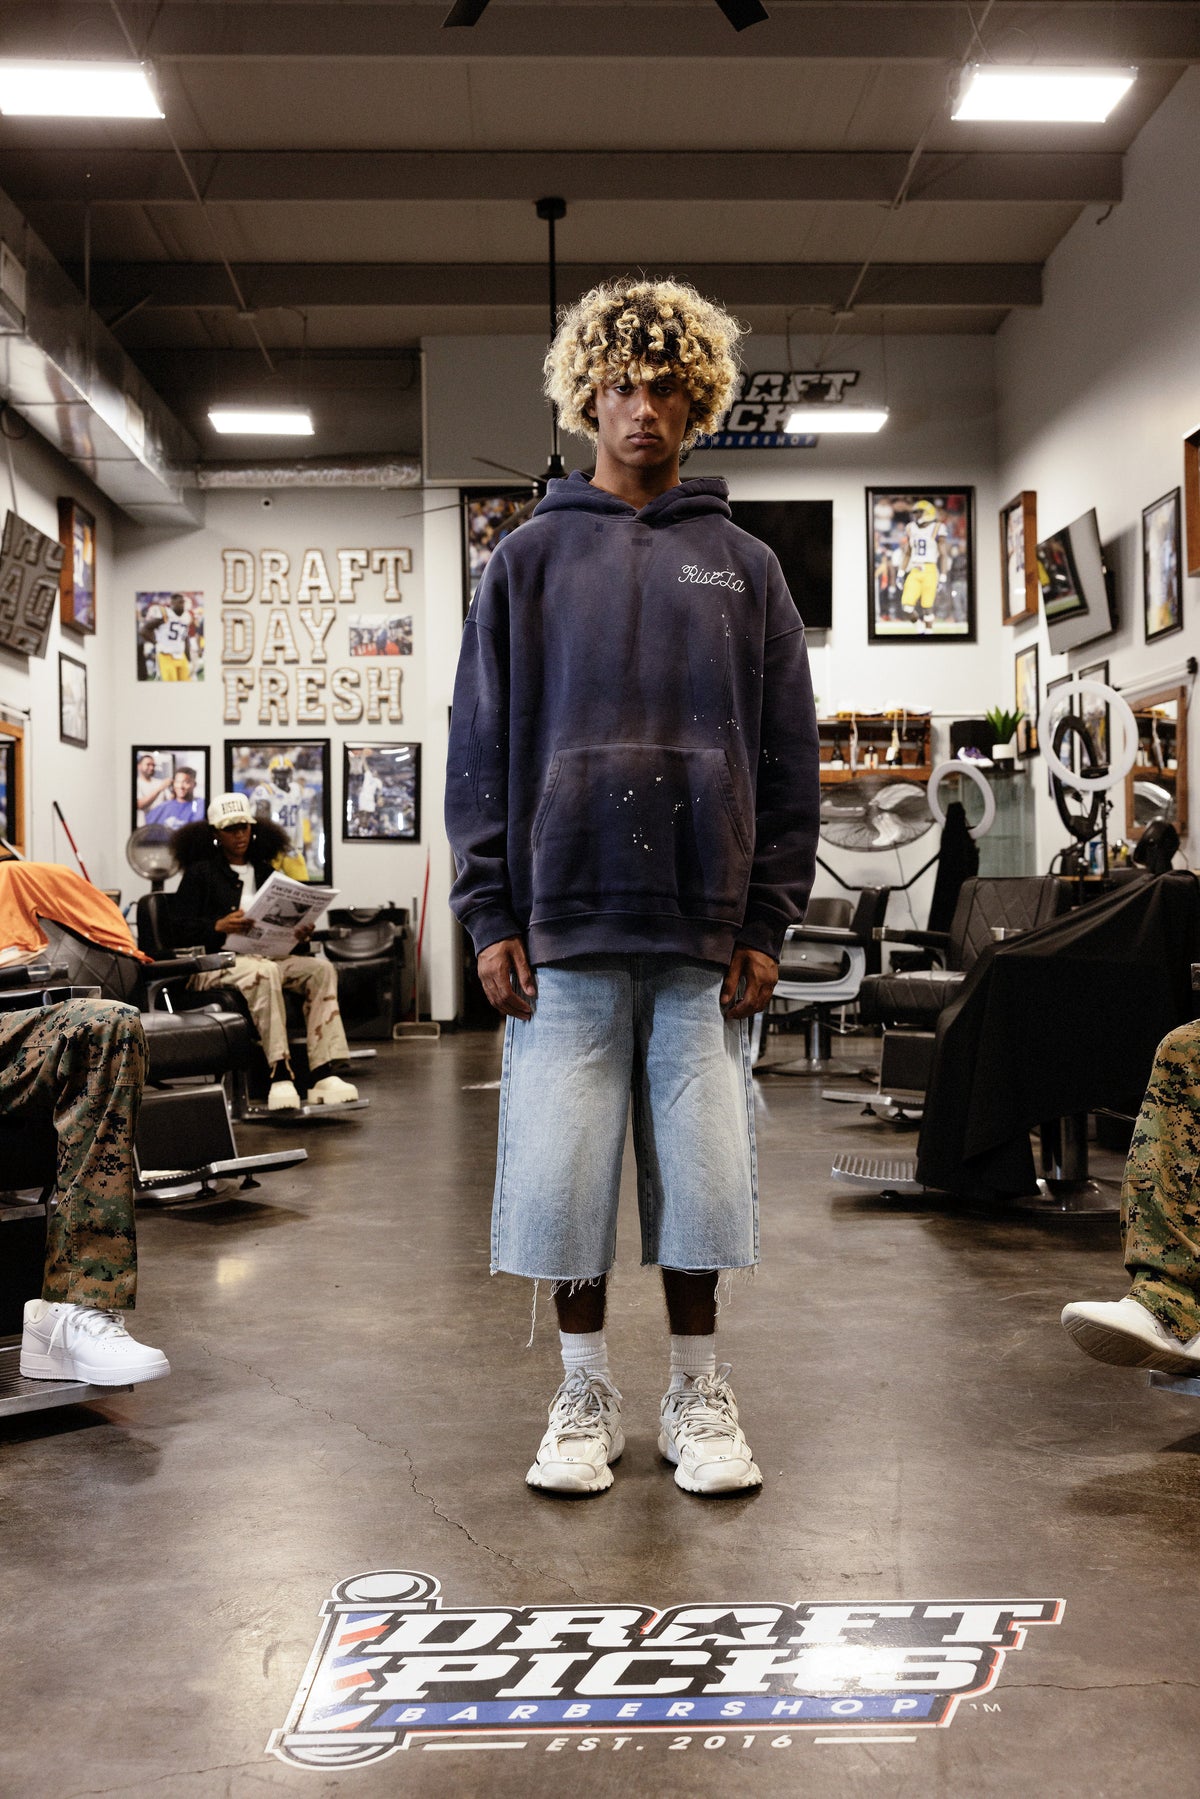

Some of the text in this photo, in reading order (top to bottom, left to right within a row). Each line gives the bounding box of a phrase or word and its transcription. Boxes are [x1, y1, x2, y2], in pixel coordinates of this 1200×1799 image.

[735, 373, 857, 401] AFT
[222, 548, 412, 604] DRAFT
[678, 564, 745, 593] RiseLa
[221, 608, 336, 664] DAY
[222, 667, 403, 725] FRESH
[361, 1604, 1044, 1653] DRAFT
[360, 1646, 983, 1700] PICKS
[395, 1699, 918, 1723] BARBERSHOP
[545, 1734, 793, 1752] EST. 2016
